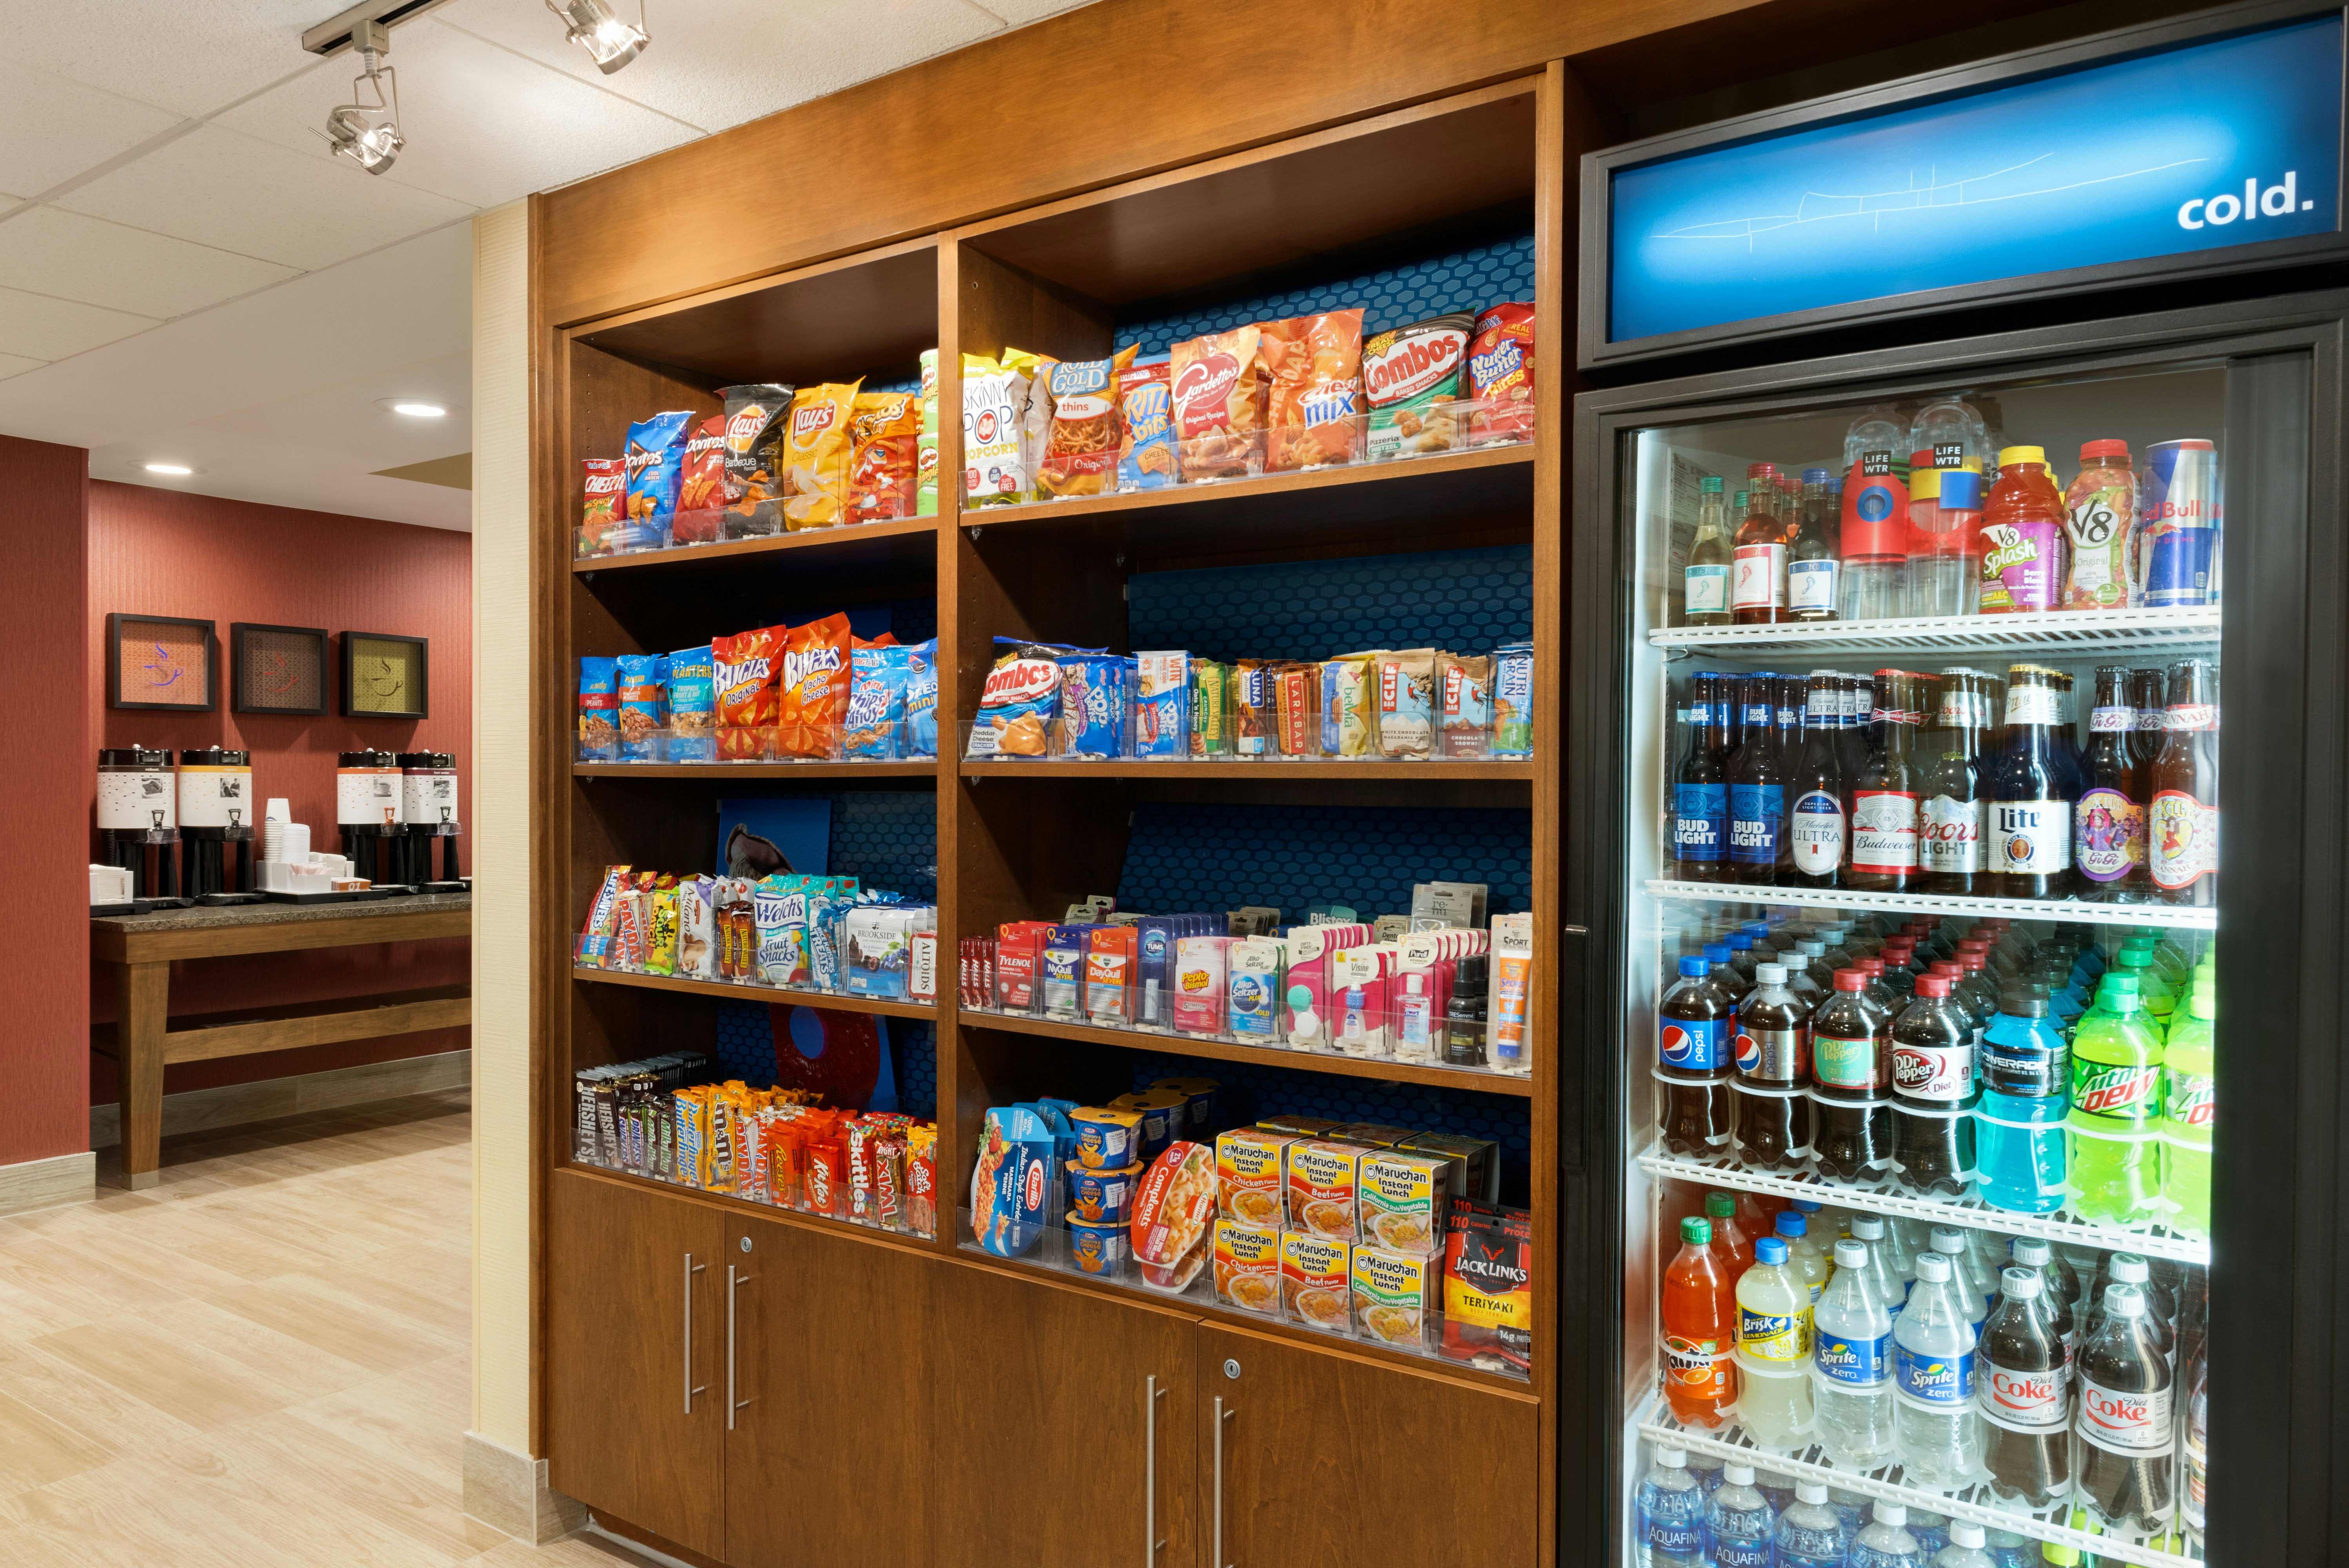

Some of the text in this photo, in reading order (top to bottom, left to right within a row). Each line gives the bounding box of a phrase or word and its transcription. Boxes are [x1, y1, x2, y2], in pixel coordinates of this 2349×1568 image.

[2178, 171, 2313, 230] cold.
[1511, 323, 1530, 332] REAL
[1365, 335, 1459, 394] Combos
[1054, 369, 1105, 393] GOLD
[1396, 372, 1438, 397] BAKED SNACKS
[1487, 369, 1525, 400] Bites
[1172, 363, 1238, 420] Gardetto's
[1062, 402, 1089, 412] thins
[1125, 387, 1169, 420] RITZ
[794, 406, 835, 436] Lay's
[1186, 411, 1225, 424] Original Recipe
[1134, 415, 1169, 441] bits
[1370, 436, 1399, 446] Pizzeria
[1371, 443, 1399, 453] PRETZEL
[792, 449, 818, 462] Classic
[964, 442, 1018, 461] POPCORN
[1144, 448, 1169, 460] CHEESE
[1864, 454, 1888, 464] LIFE
[1935, 446, 1961, 456] LIFE
[725, 457, 756, 468] Barbecue
[1075, 457, 1112, 469] Original
[1864, 464, 1888, 473] WTR
[1935, 456, 1961, 465] WTR
[2070, 499, 2112, 543] V8
[1997, 525, 2016, 546] V8
[1983, 539, 2039, 576] Splash
[2077, 555, 2108, 567] Original
[672, 665, 712, 681] PLANTERS
[784, 645, 840, 696] BUGLES
[1169, 658, 1181, 682] WIN
[1504, 656, 1516, 697] GRAIN
[1516, 656, 1528, 697] NUTRI
[713, 657, 770, 703] BUGLES
[802, 675, 826, 691] Nacho
[1384, 666, 1398, 701] CLIF
[1447, 669, 1463, 703] CLIF
[802, 686, 829, 706] Cheese
[1010, 693, 1029, 701] SNACKS
[1207, 680, 1219, 710] NATURE
[908, 694, 934, 715] mini
[1344, 687, 1356, 728] belVita
[2092, 714, 2124, 731] GiGi
[2086, 797, 2125, 811] EXILE
[2154, 801, 2197, 819] EXILE
[1677, 819, 1709, 834] BUD
[1733, 820, 1766, 834] BUD
[1920, 812, 1979, 841] Coors
[1999, 808, 2041, 833] Lite
[1674, 830, 1717, 844] LIGHT
[1730, 832, 1773, 847] LIGHT
[1794, 828, 1841, 843] ULTRA
[1855, 835, 1917, 850] Budweiser
[1922, 842, 1968, 856] LIGHT
[2088, 851, 2119, 866] GiGi
[2154, 863, 2191, 875] HANNAH
[684, 885, 695, 933] Milano
[755, 898, 803, 922] Welch's
[619, 899, 640, 966] PAYDAY
[648, 906, 659, 948] PATCH
[655, 909, 668, 946] SOUR
[857, 930, 896, 940] BROOKSIDE
[765, 937, 789, 951] Fruit
[1503, 936, 1528, 946] SPORT
[759, 948, 795, 965] Snacks
[810, 929, 828, 975] TREATS
[821, 942, 835, 973] KRISPIES
[1410, 949, 1428, 958] Purell
[921, 942, 930, 991] ALTOIDS
[999, 955, 1031, 968] TYLENOL
[1047, 963, 1072, 975] NyQuil
[1351, 963, 1369, 972] Visine
[1090, 967, 1120, 980] DayQuil
[1182, 971, 1210, 983] Pepto-
[1185, 978, 1209, 991] Bismol
[1500, 978, 1525, 987] SPORT
[1233, 988, 1259, 997] Seltzer
[1694, 1030, 1706, 1062] pepsi
[1766, 1041, 1777, 1075] pepsi
[1932, 1082, 1952, 1093] Diet
[2082, 1067, 2132, 1092] Mtn
[2084, 1065, 2159, 1112] DEW
[581, 1086, 596, 1161] HERSHEY'S
[598, 1102, 615, 1158] HERSHEY'S
[877, 1145, 897, 1156] RIGHT
[1231, 1145, 1275, 1161] Maruchan
[1234, 1156, 1263, 1167] Instant
[1237, 1165, 1260, 1174] Lunch
[1303, 1154, 1349, 1172] Maruchan
[850, 1131, 866, 1214] Skittles
[1306, 1166, 1337, 1178] Instant
[1309, 1175, 1334, 1185] Lunch
[1375, 1165, 1427, 1183] Maruchan
[877, 1157, 898, 1222] TWIX
[1006, 1166, 1015, 1202] MARINARA
[1027, 1170, 1044, 1209] Barilla
[1233, 1175, 1264, 1187] Chicken
[1378, 1177, 1414, 1190] Instant
[1311, 1187, 1330, 1199] Beef
[1382, 1187, 1410, 1198] Lunch
[1363, 1191, 1428, 1213] California Vegetable
[1450, 1216, 1469, 1229] 110
[1367, 1258, 1419, 1278] Maruchan
[1454, 1256, 1527, 1282] JACK LINK'S
[1463, 1295, 1514, 1314] TERIYAKI
[1744, 1327, 1785, 1338] LEMONADE
[1819, 1347, 1857, 1367] Sprite
[1832, 1367, 1857, 1379] zero
[1911, 1368, 1955, 1388] Sprite
[2031, 1376, 2053, 1386] Diet
[1926, 1389, 1954, 1399] zero
[1993, 1373, 2053, 1398] Coke
[2086, 1389, 2148, 1421] Coke
[2123, 1397, 2148, 1408] Diet
[1649, 1526, 1701, 1546] AQUAFINA
[1715, 1545, 1770, 1567] AQUAFINA
